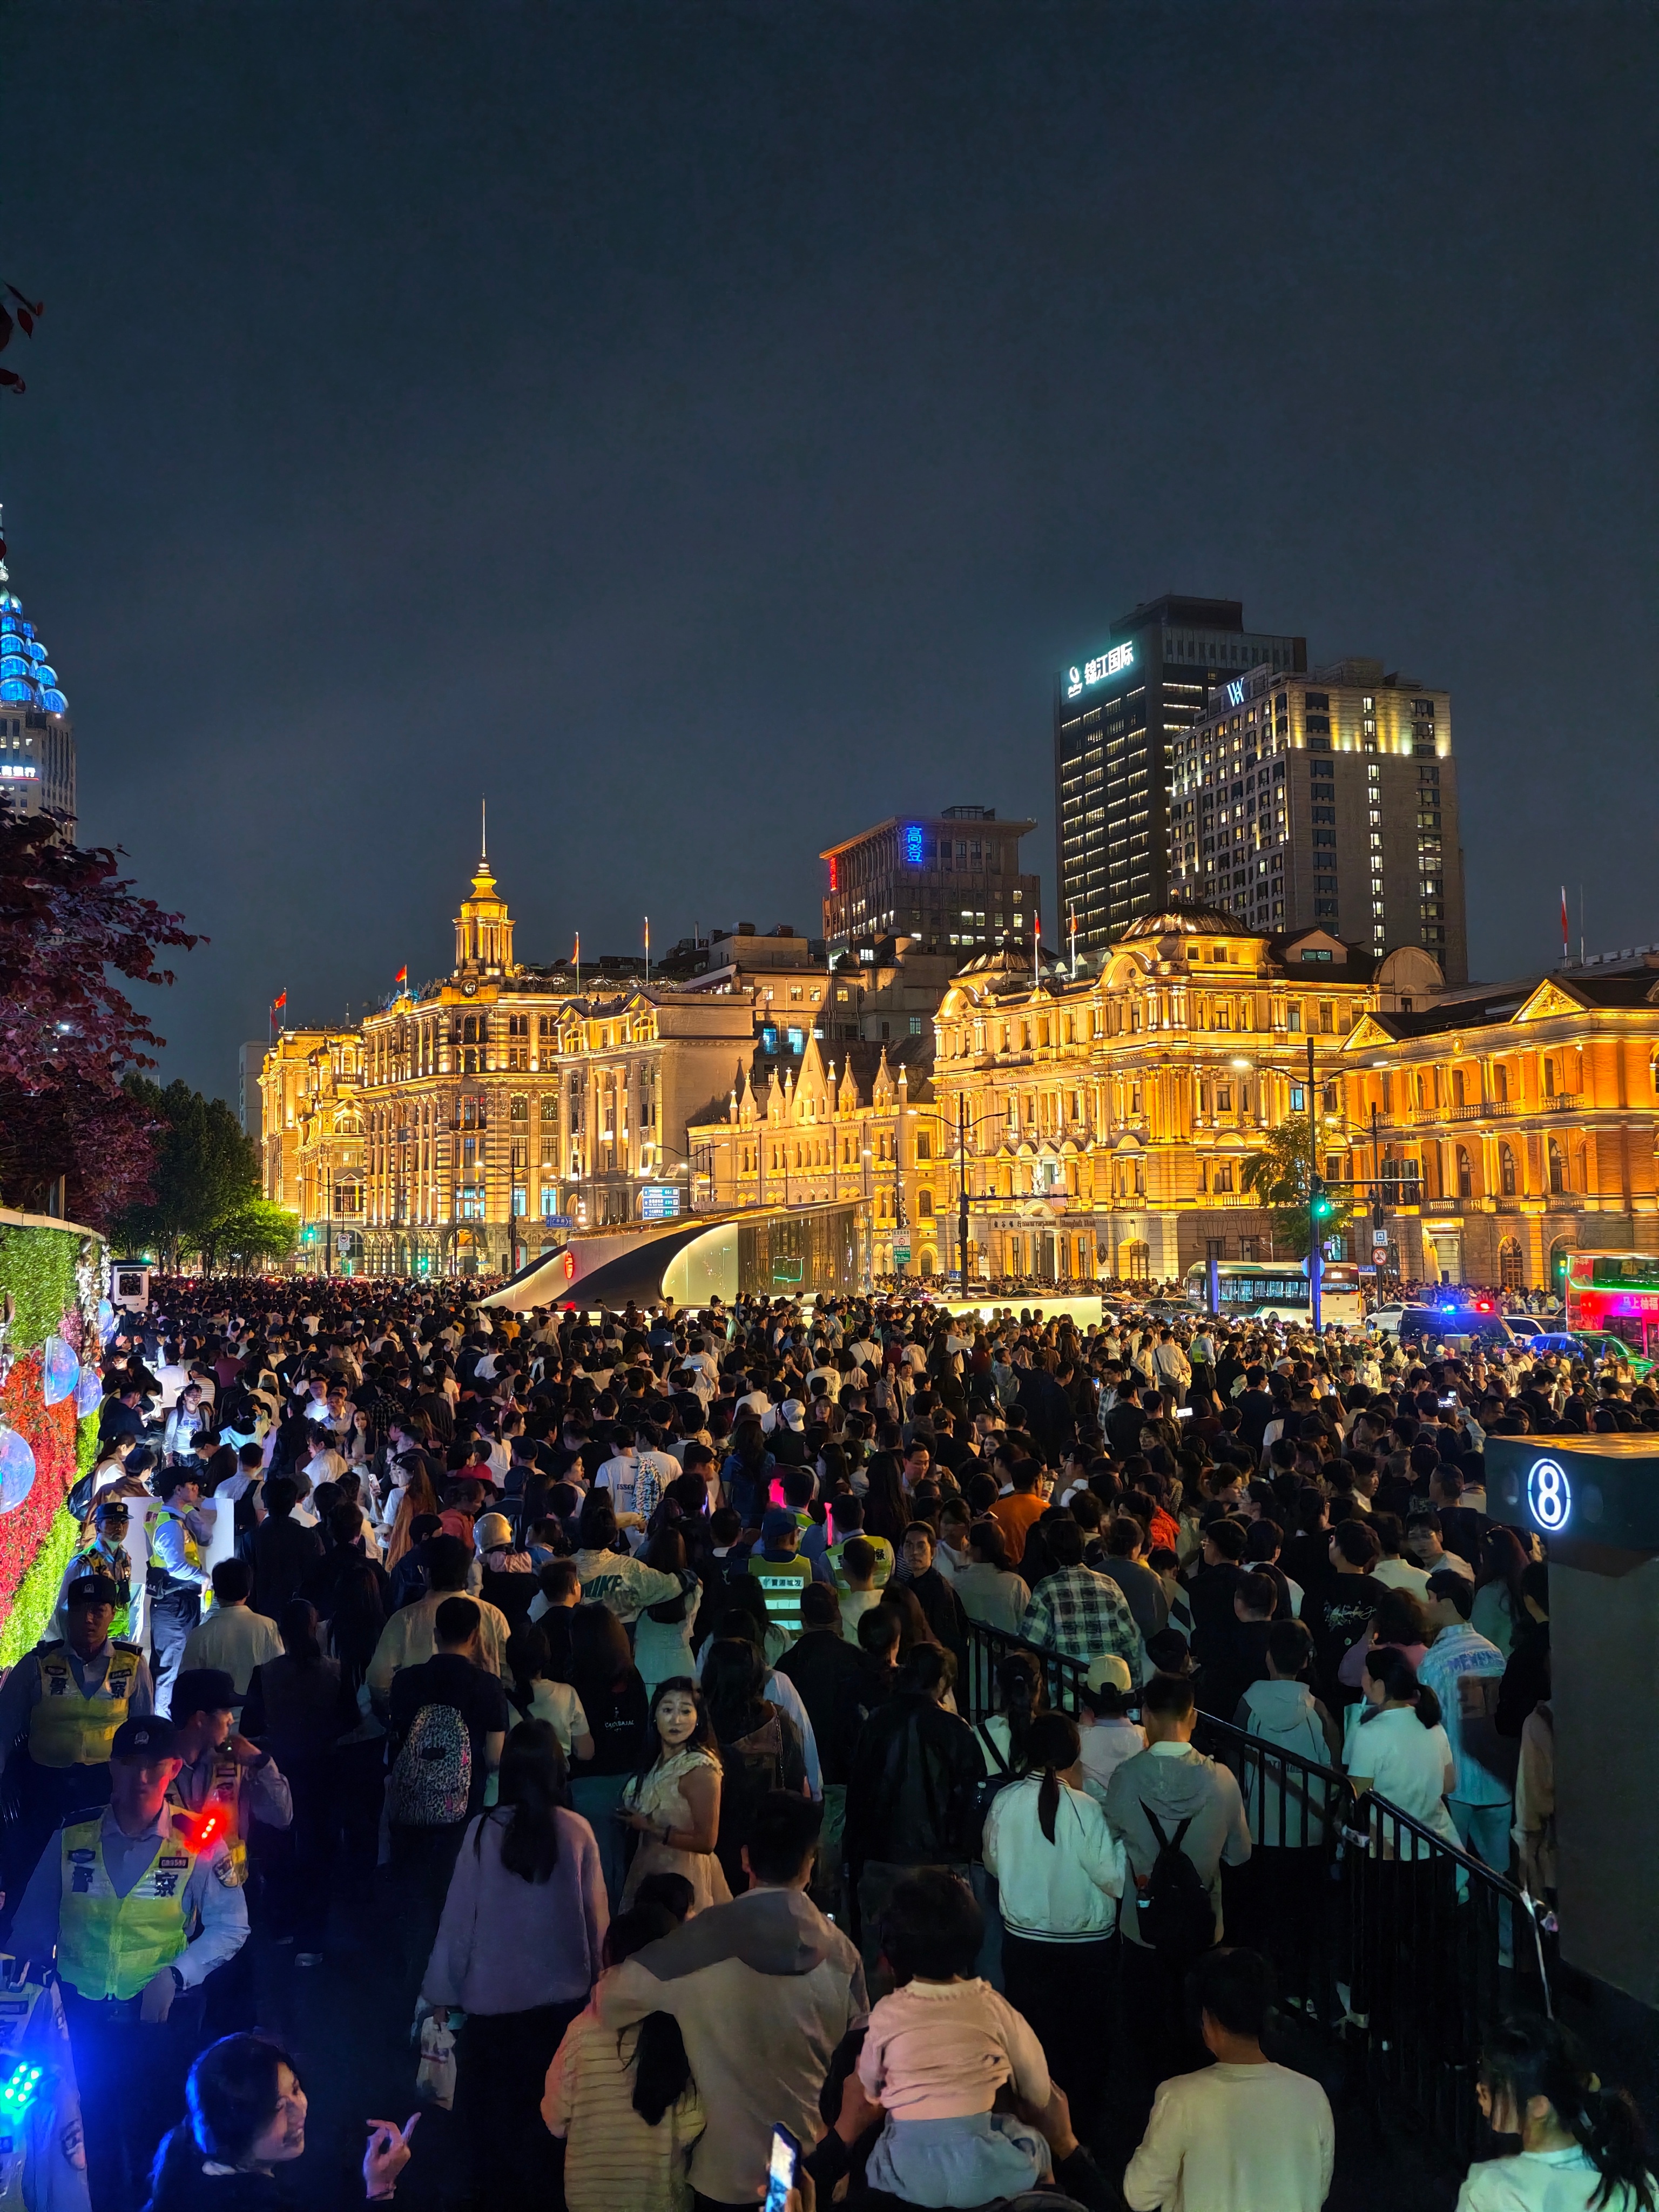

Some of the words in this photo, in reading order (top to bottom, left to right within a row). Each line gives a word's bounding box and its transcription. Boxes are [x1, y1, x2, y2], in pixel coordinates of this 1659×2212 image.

[1084, 640, 1134, 685] 锦江国际
[907, 826, 923, 862] 高登
